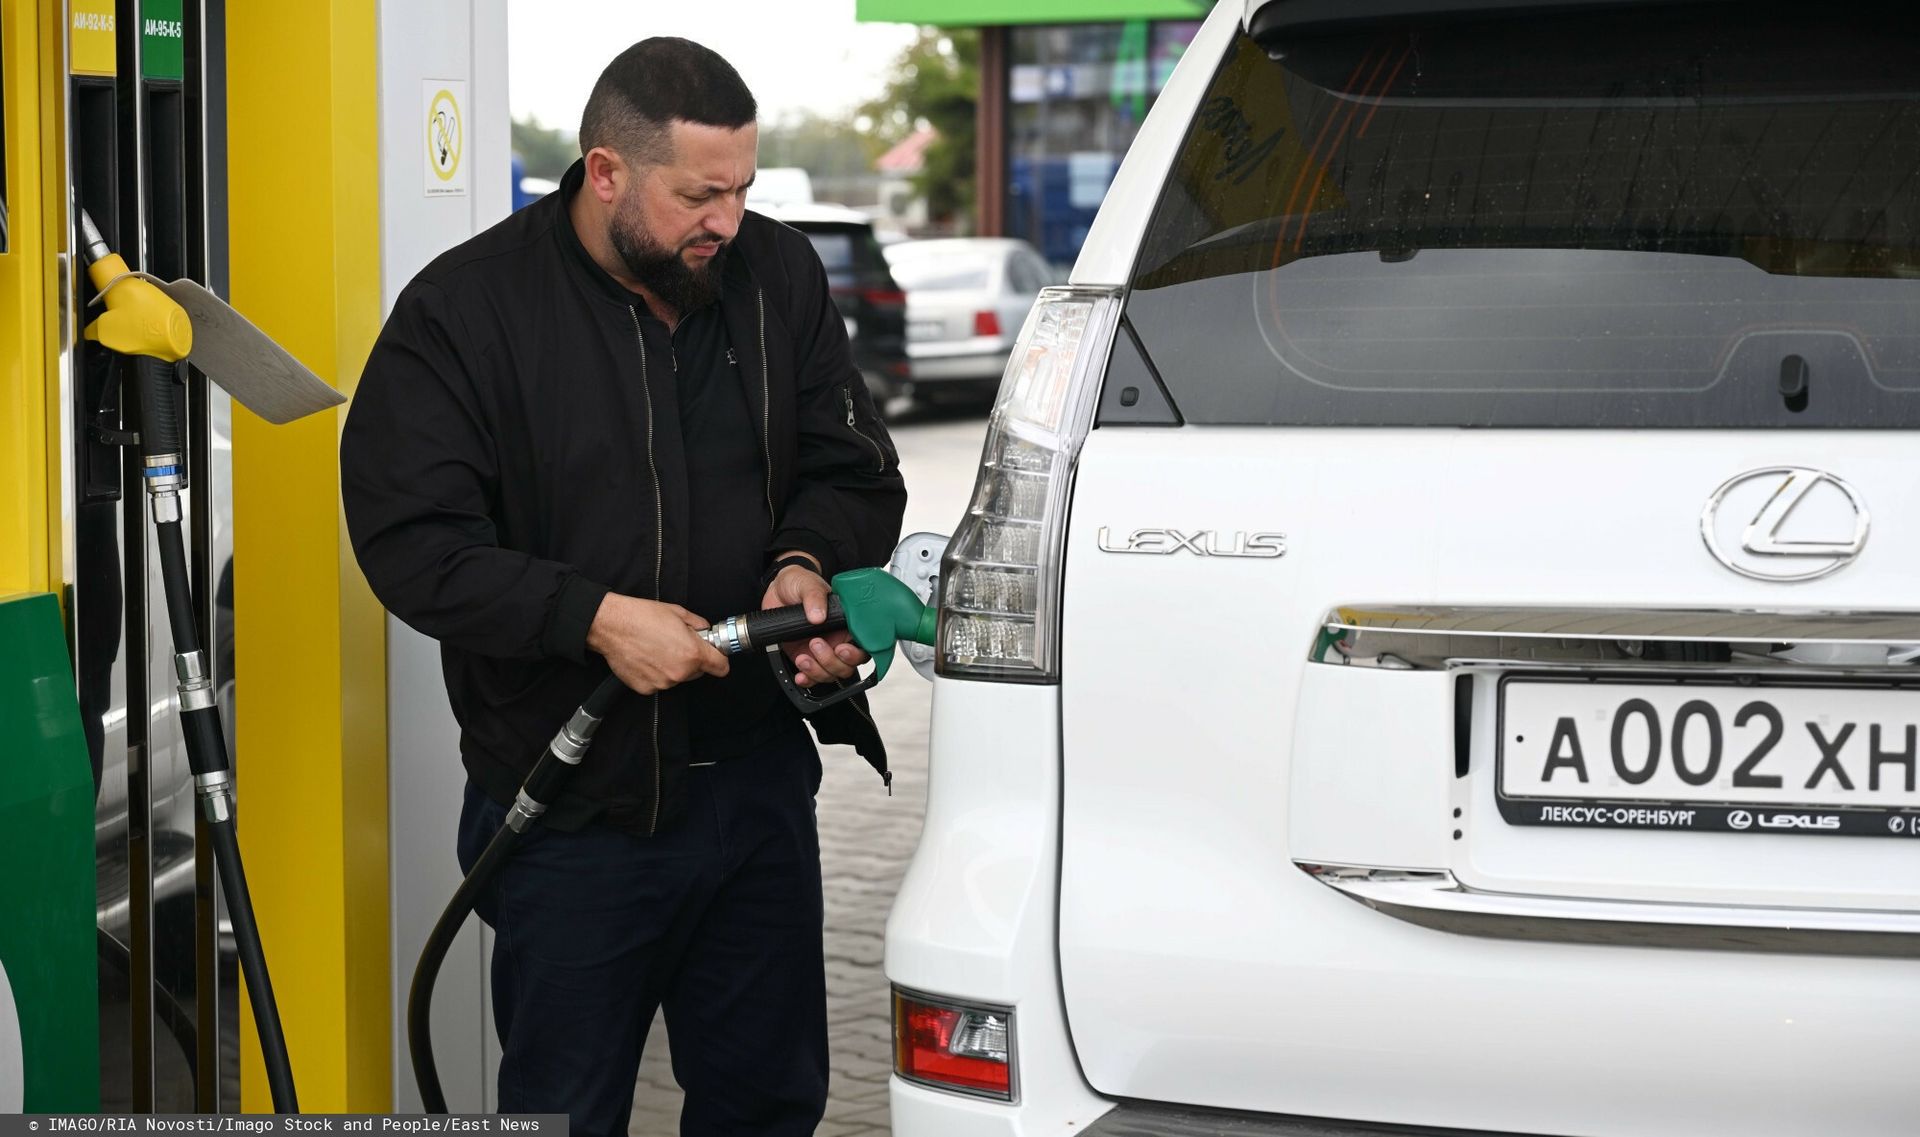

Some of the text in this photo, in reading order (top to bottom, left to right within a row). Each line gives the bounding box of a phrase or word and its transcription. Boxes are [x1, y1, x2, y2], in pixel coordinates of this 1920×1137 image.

[74, 12, 114, 32] АИ-92-К-5
[145, 19, 182, 38] АИ-95-К-5
[1098, 526, 1287, 558] LEXUS
[1540, 806, 1696, 826] ЛЕКСУС-ОРЕНБУРГ
[1758, 813, 1841, 829] LEXUS
